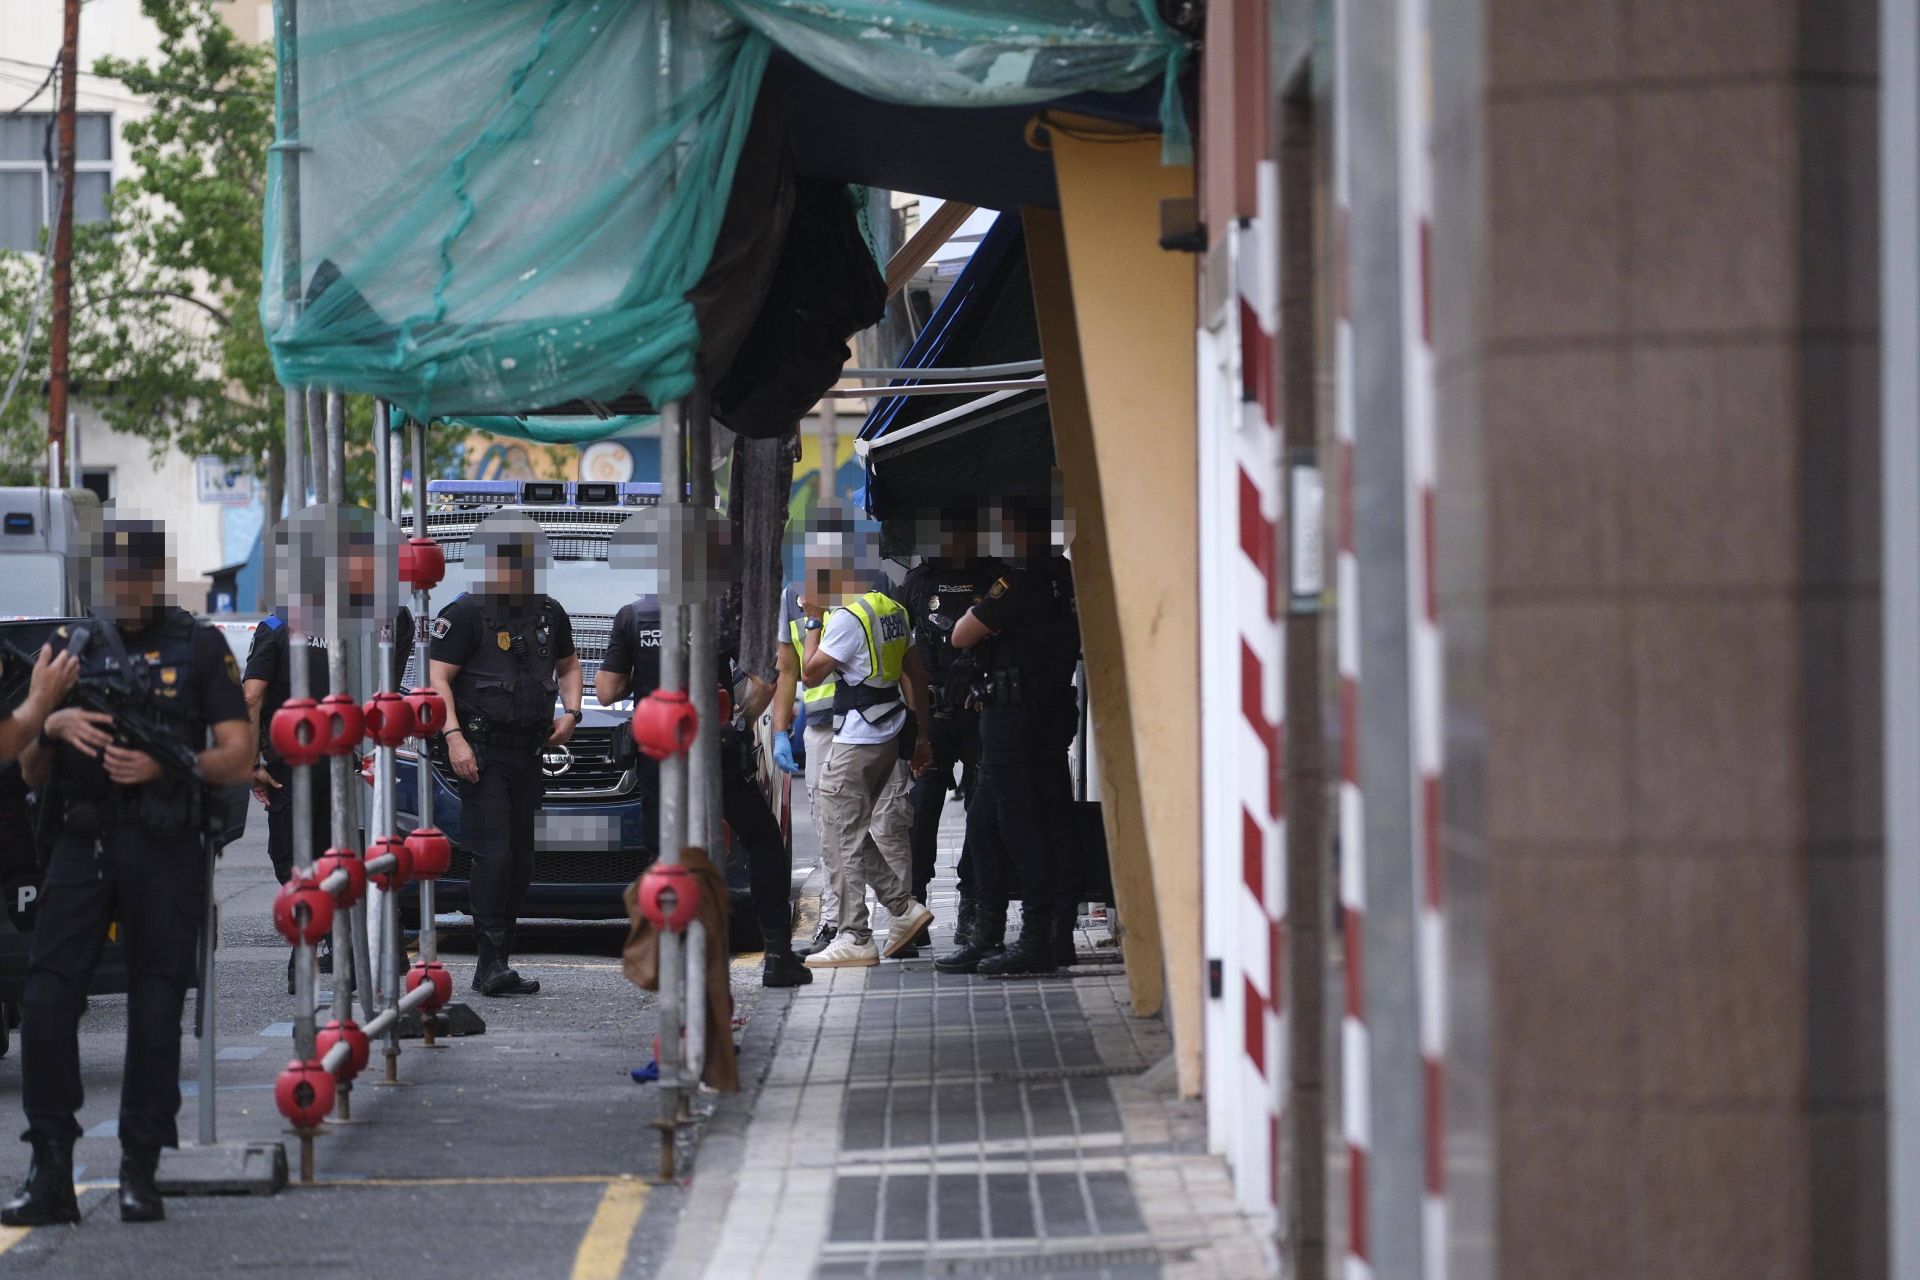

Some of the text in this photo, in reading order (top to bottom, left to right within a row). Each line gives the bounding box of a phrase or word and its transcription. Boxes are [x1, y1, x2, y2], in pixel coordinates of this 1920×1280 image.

[640, 630, 662, 638] PO
[883, 624, 905, 641] LOCAL
[18, 885, 37, 912] P
